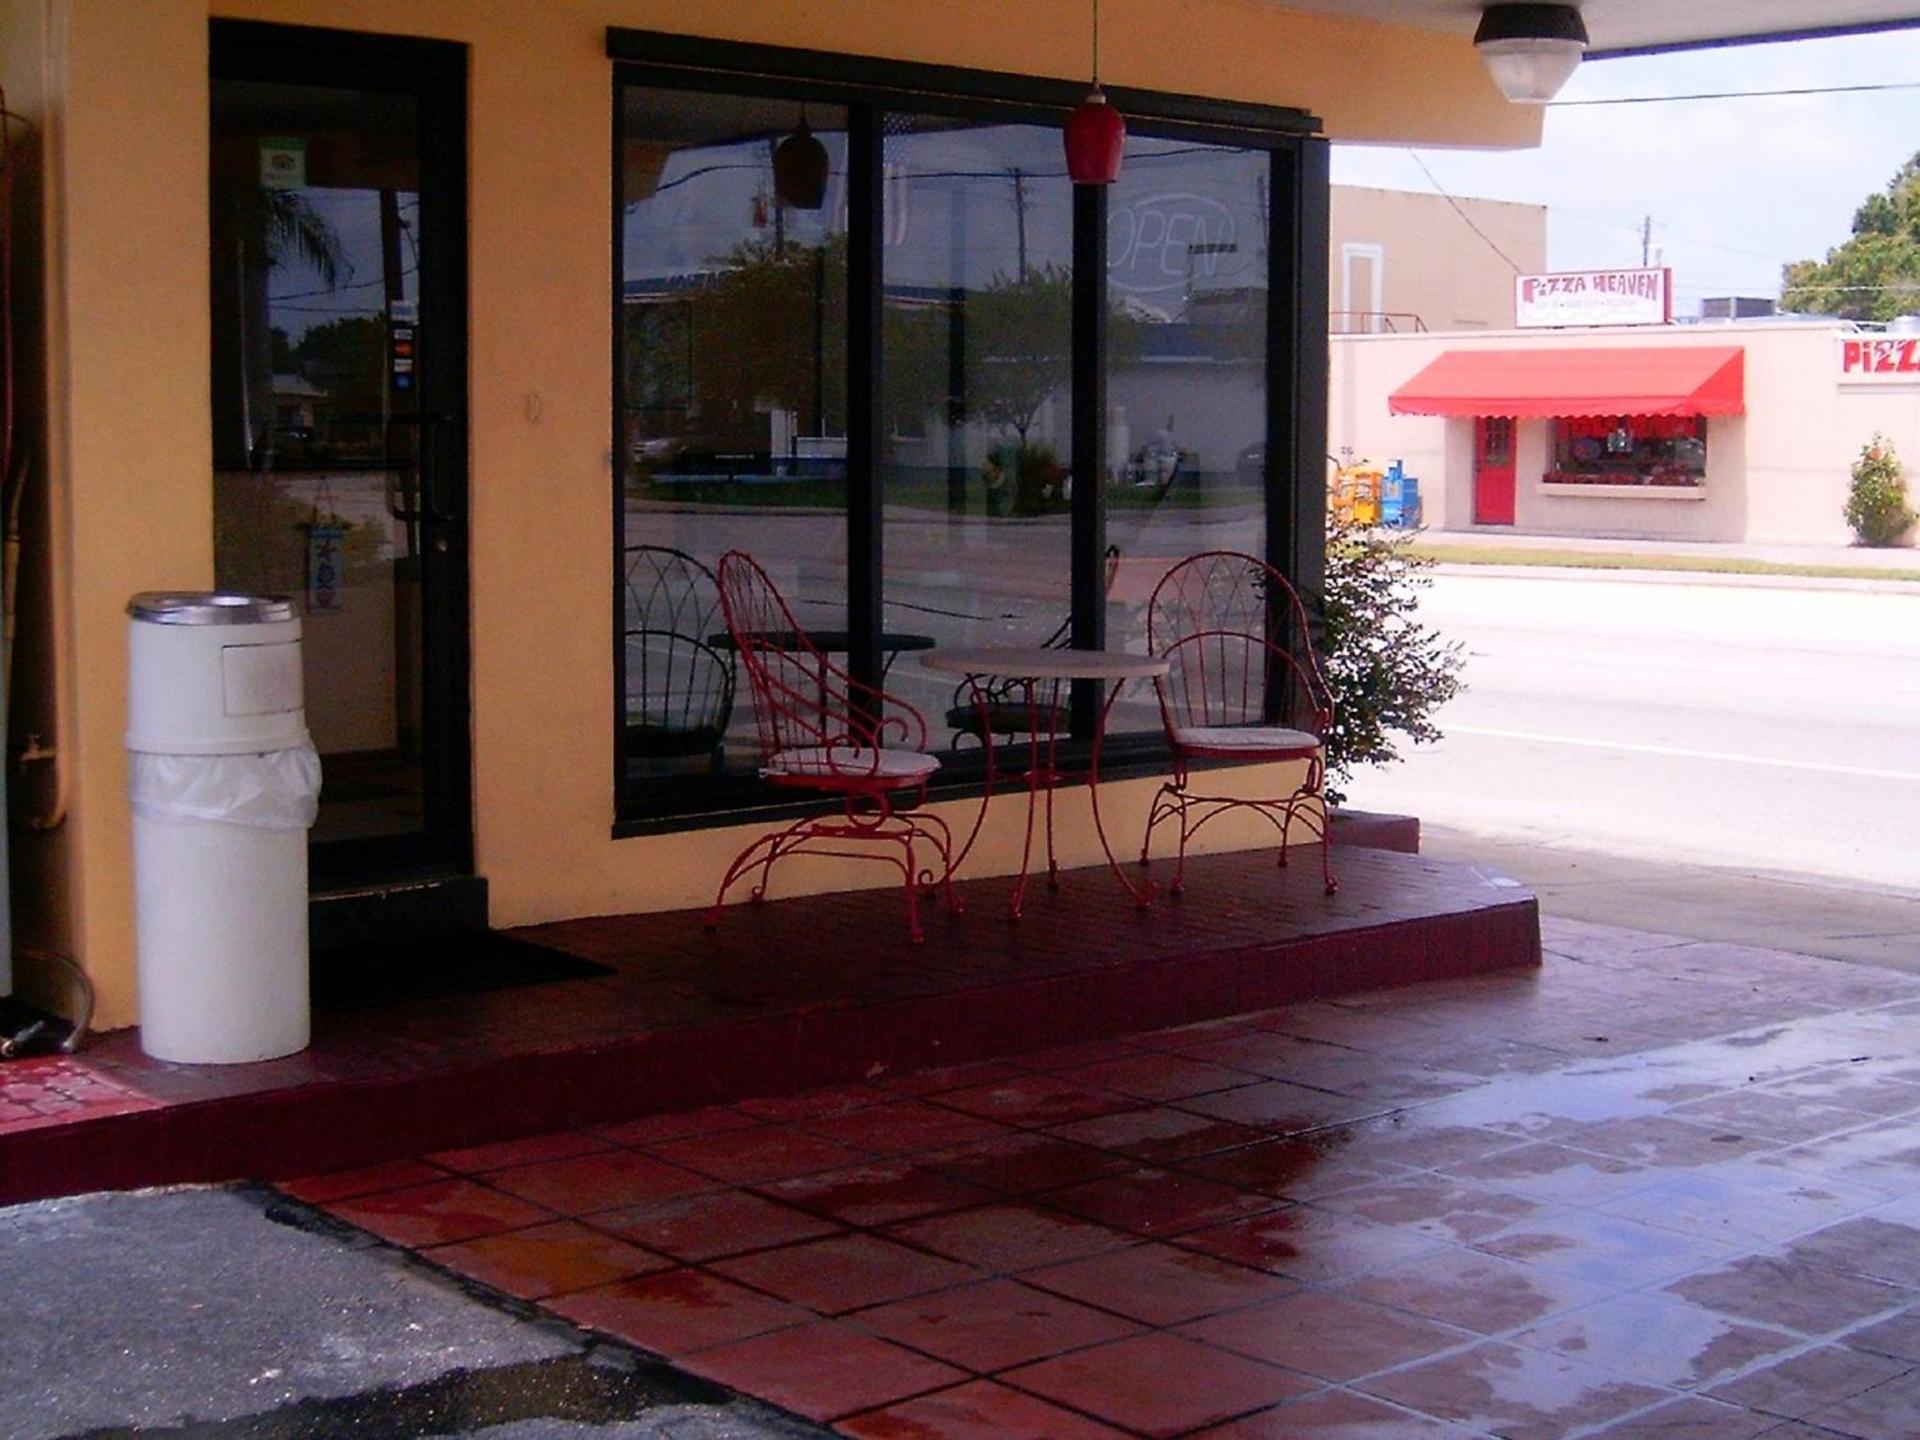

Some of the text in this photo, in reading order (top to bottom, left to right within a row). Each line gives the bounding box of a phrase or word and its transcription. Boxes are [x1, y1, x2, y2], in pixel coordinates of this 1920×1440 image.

[1107, 208, 1226, 276] OPEN
[1592, 273, 1659, 302] HEAVEN
[1843, 339, 1920, 374] PiZZ
